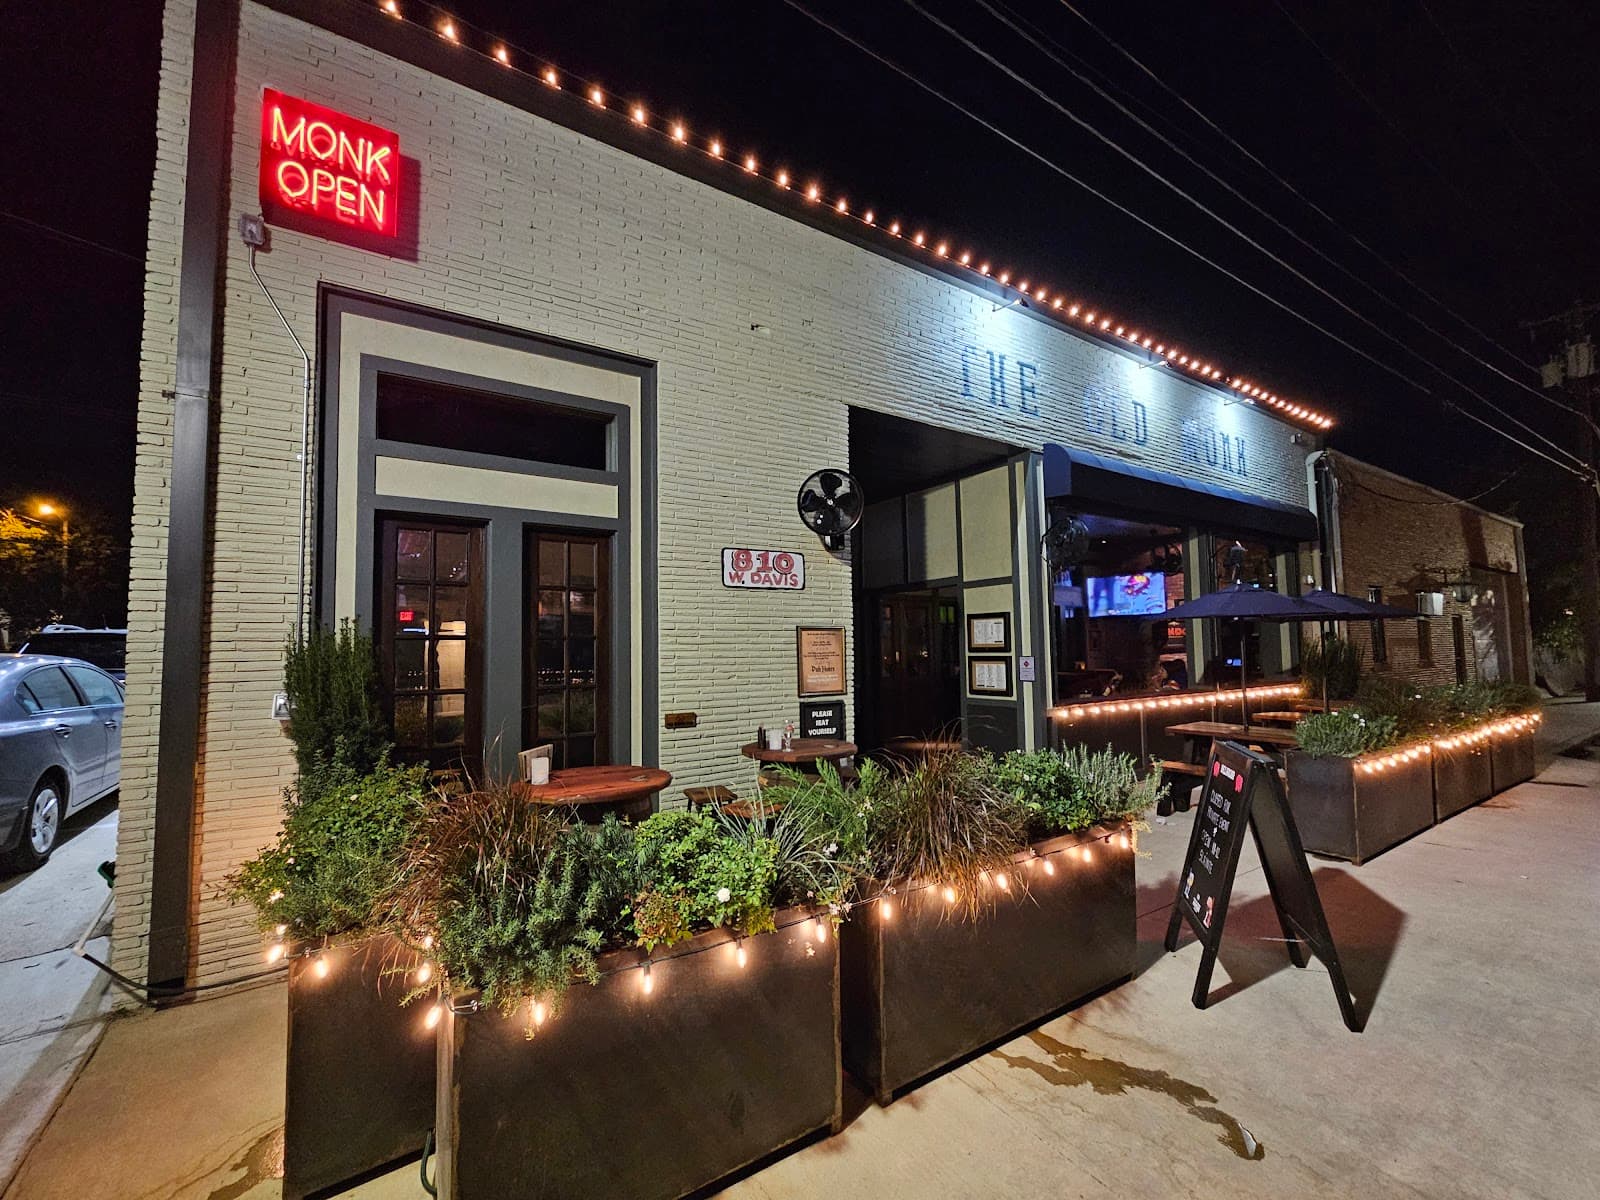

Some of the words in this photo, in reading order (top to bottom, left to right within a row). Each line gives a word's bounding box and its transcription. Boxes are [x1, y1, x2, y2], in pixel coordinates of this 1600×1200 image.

[272, 107, 391, 180] MONK
[277, 161, 385, 223] OPEN
[960, 345, 1040, 417] THE
[1083, 385, 1149, 448] OLD
[732, 549, 795, 575] 810
[729, 571, 745, 585] W.
[750, 571, 799, 588] DAVIS
[811, 710, 833, 719] PLEASE
[815, 719, 830, 727] SEAT
[808, 727, 837, 737] YOURSELF
